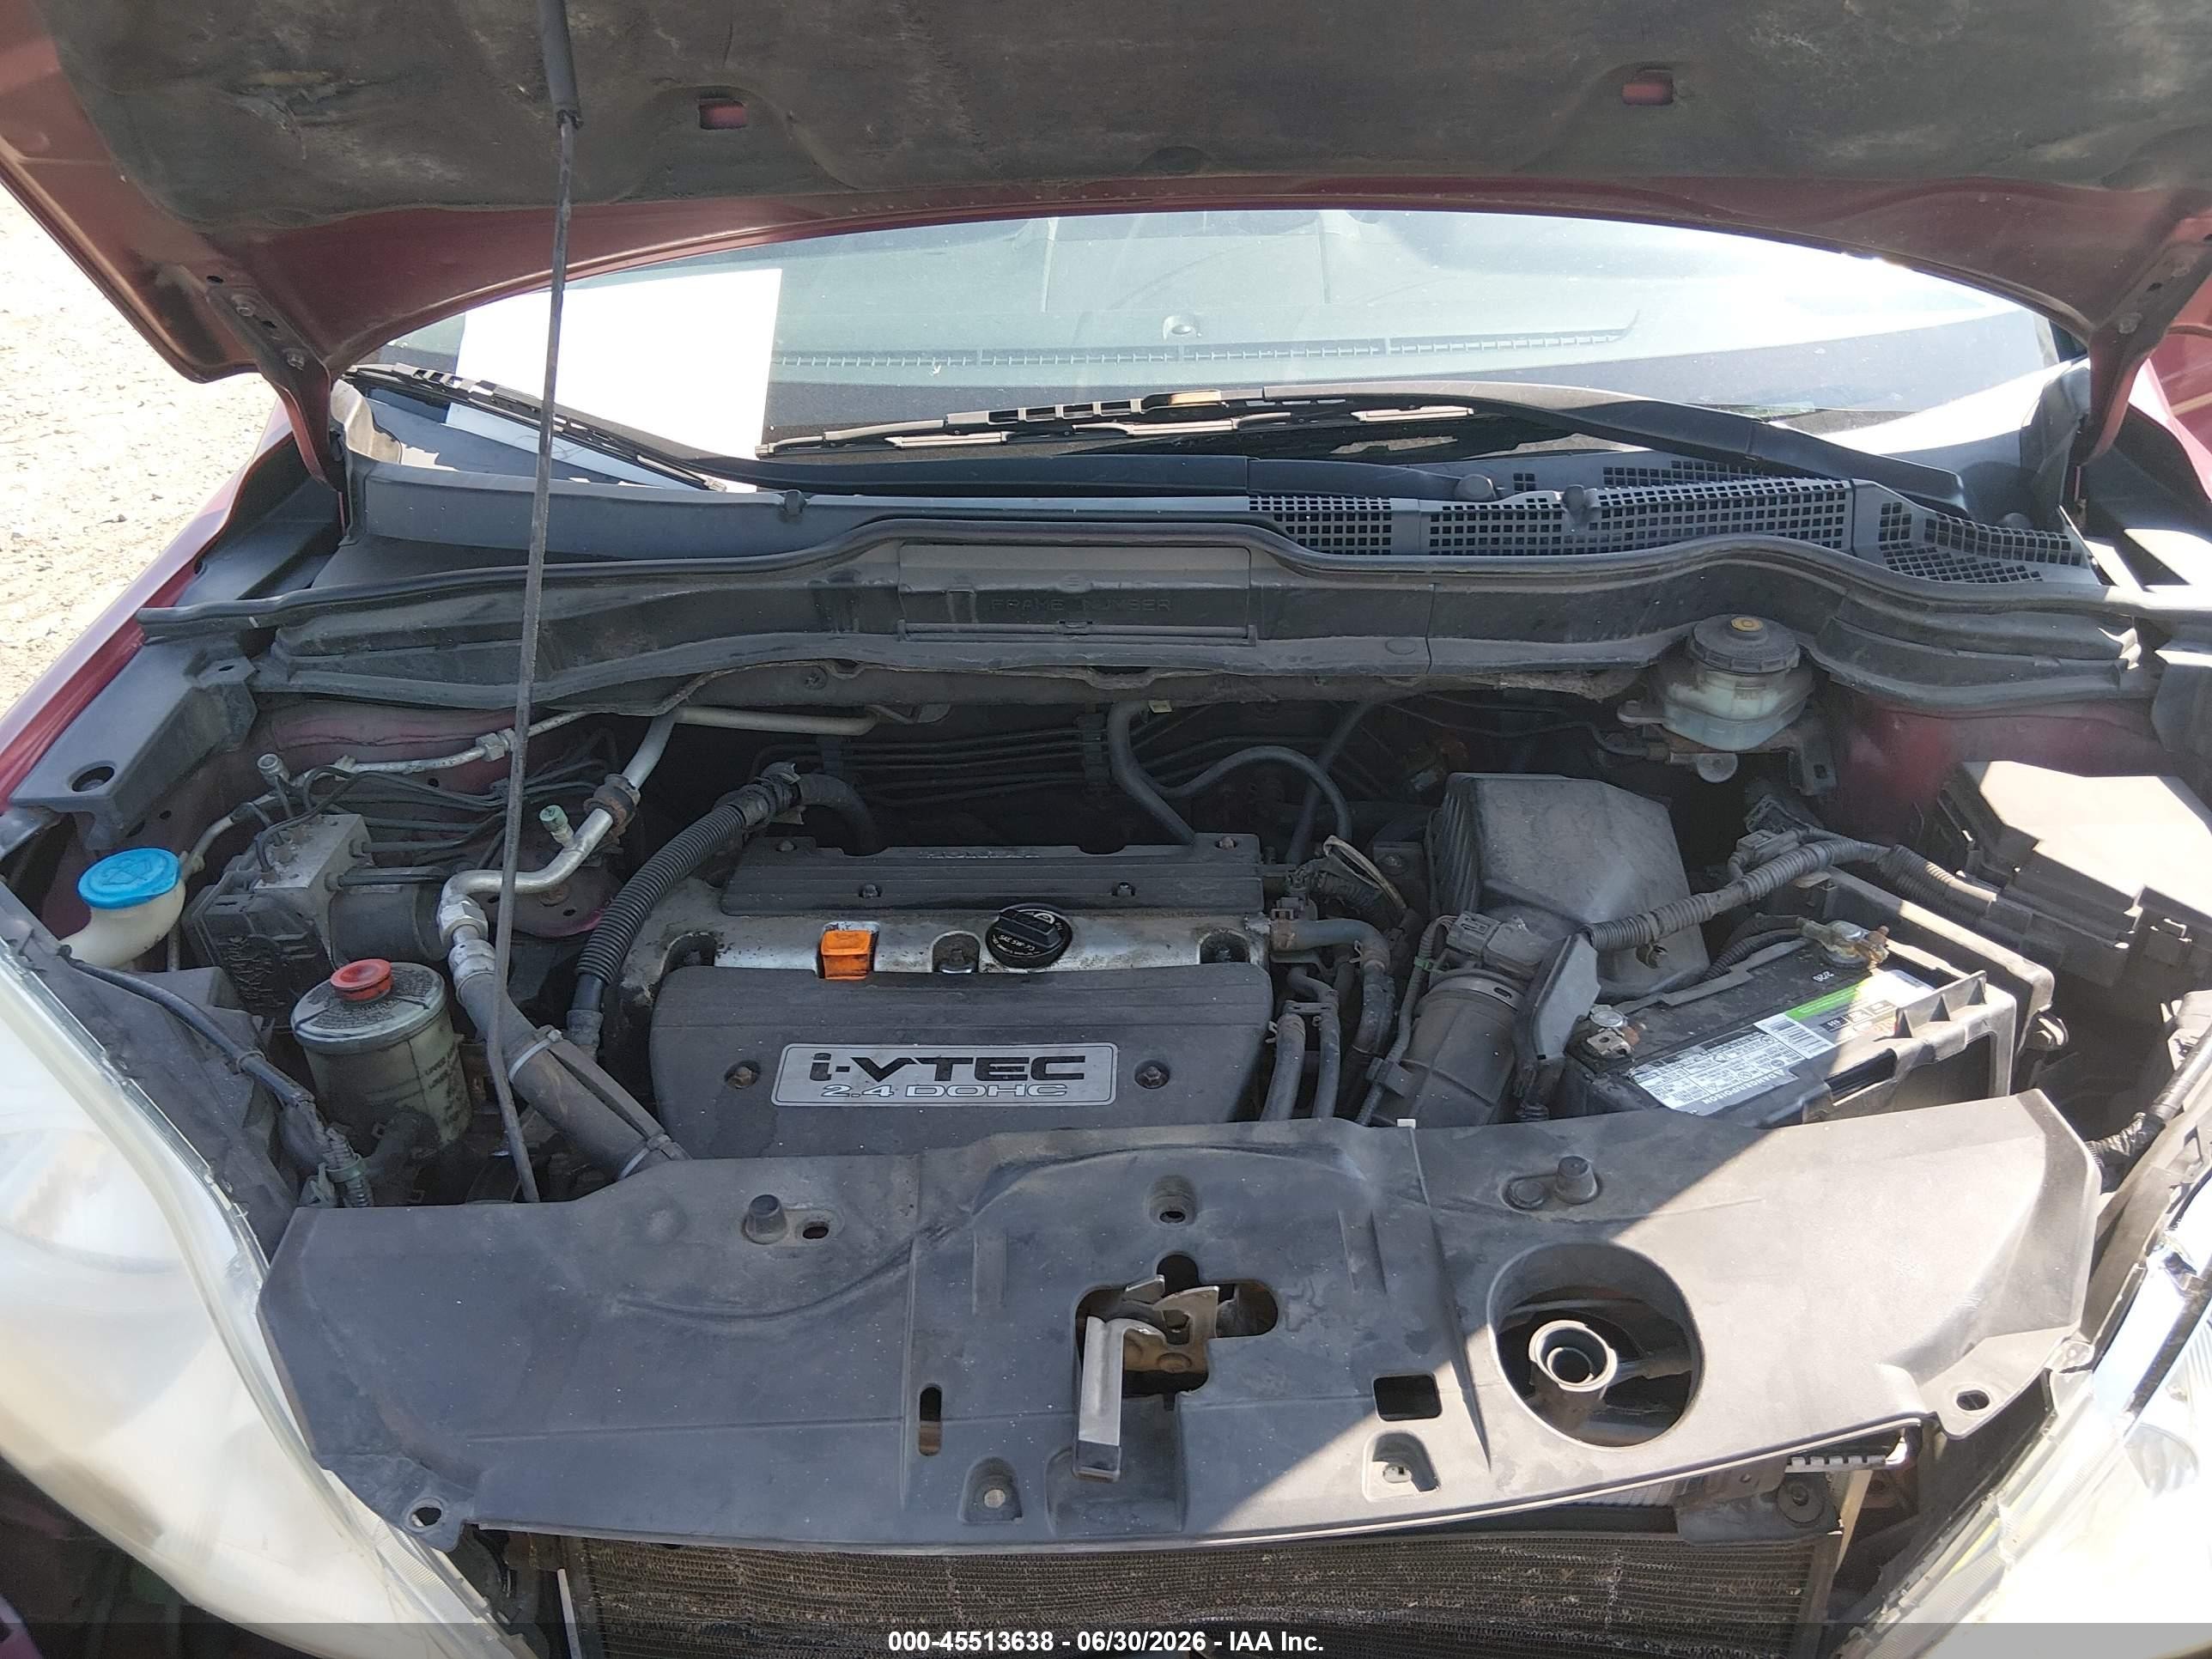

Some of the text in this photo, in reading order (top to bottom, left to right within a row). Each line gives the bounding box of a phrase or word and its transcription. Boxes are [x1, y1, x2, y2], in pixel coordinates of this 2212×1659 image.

[809, 1052, 1086, 1083] i-VTEC
[821, 1083, 1068, 1098] 2.4 DOHC
